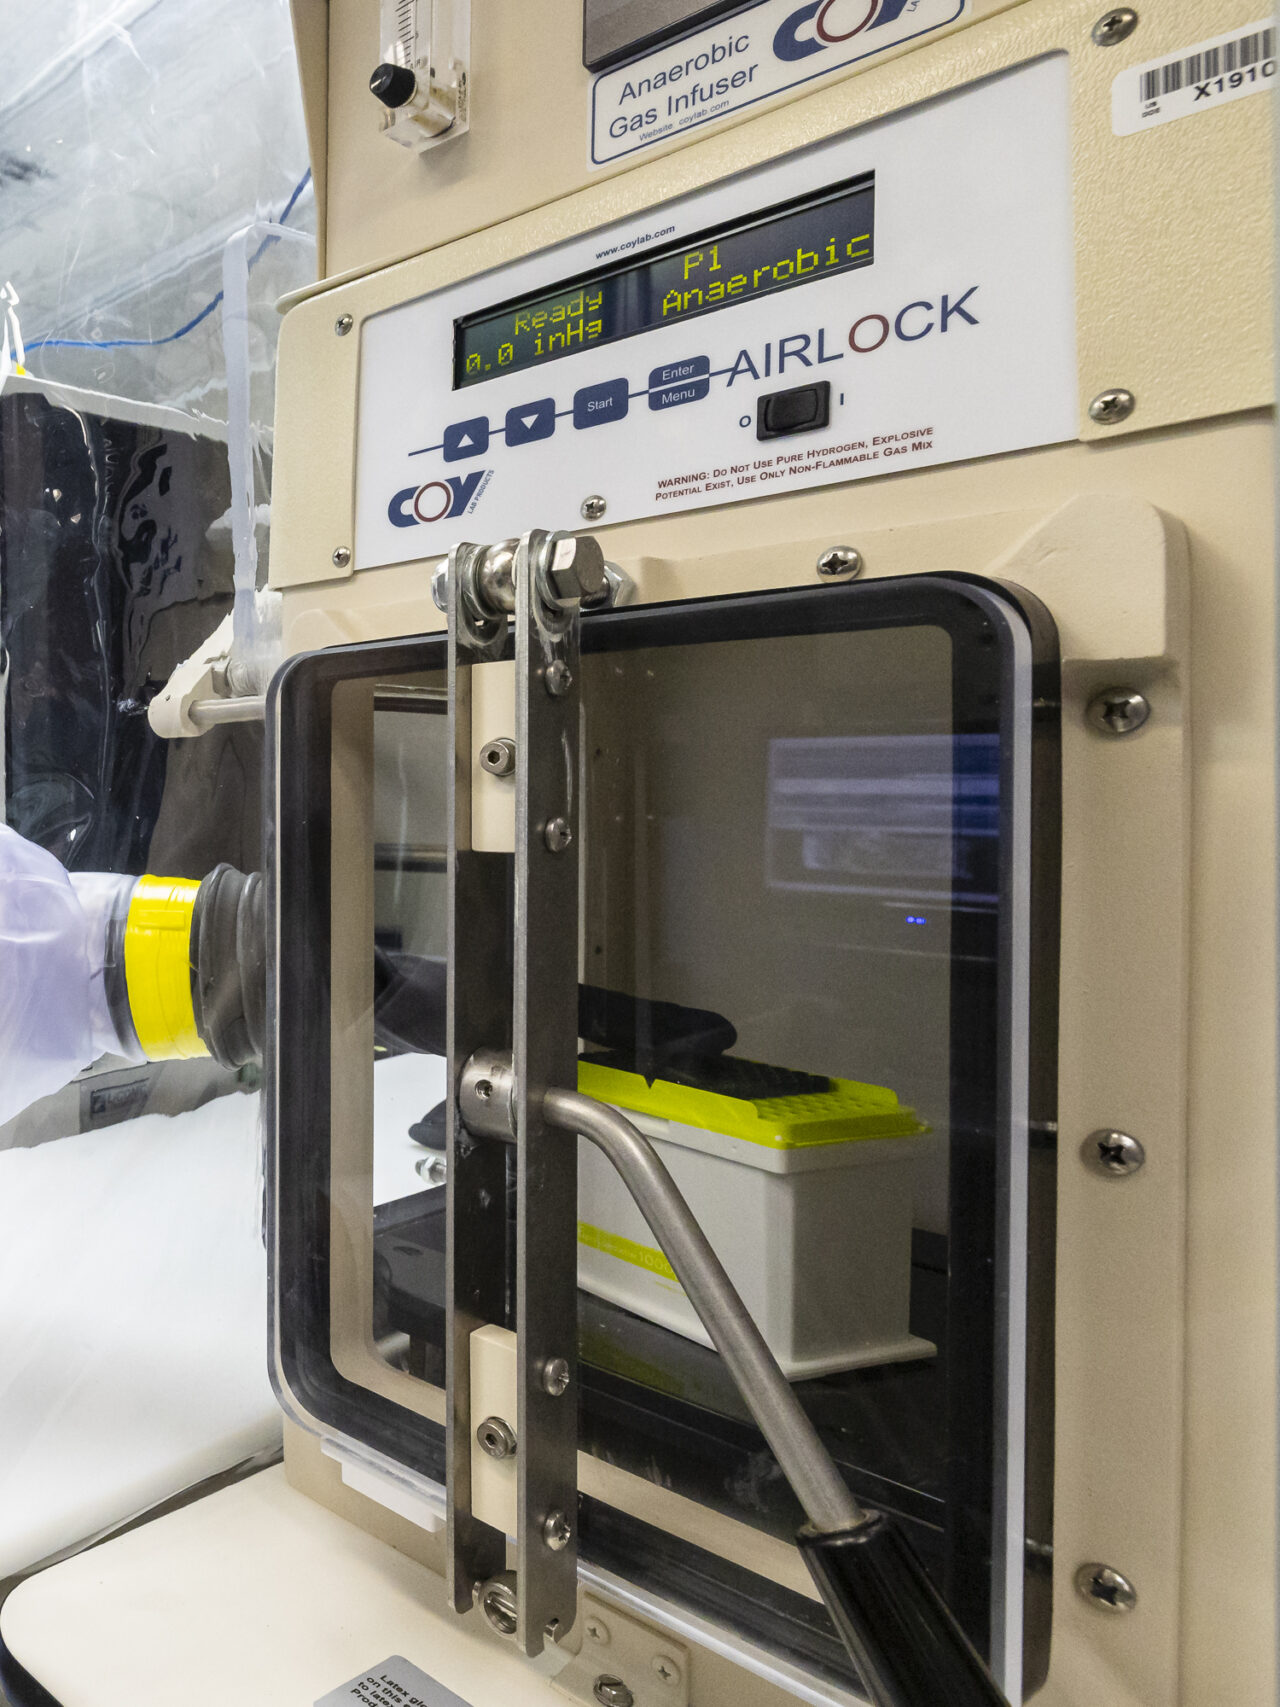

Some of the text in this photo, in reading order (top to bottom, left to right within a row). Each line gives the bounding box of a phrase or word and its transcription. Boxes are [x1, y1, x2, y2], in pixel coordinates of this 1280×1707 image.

[618, 33, 750, 105] Anaerobic
[609, 64, 759, 138] Gas Infuser
[595, 225, 676, 260] www.coylab.com
[465, 233, 871, 375] 0.0 inHg Anaerobic
[514, 245, 722, 336] Ready P1
[726, 286, 980, 387] AIRLOCK
[662, 363, 695, 382] Enter
[587, 397, 614, 412] Start
[662, 387, 696, 405] Menu
[467, 469, 495, 515] LAB PRODUCTS
[658, 472, 710, 489] WARNING:
[387, 469, 486, 528] COY
[358, 1682, 370, 1691] to
[366, 1677, 402, 1704] on this
[379, 1674, 410, 1697] Latex
